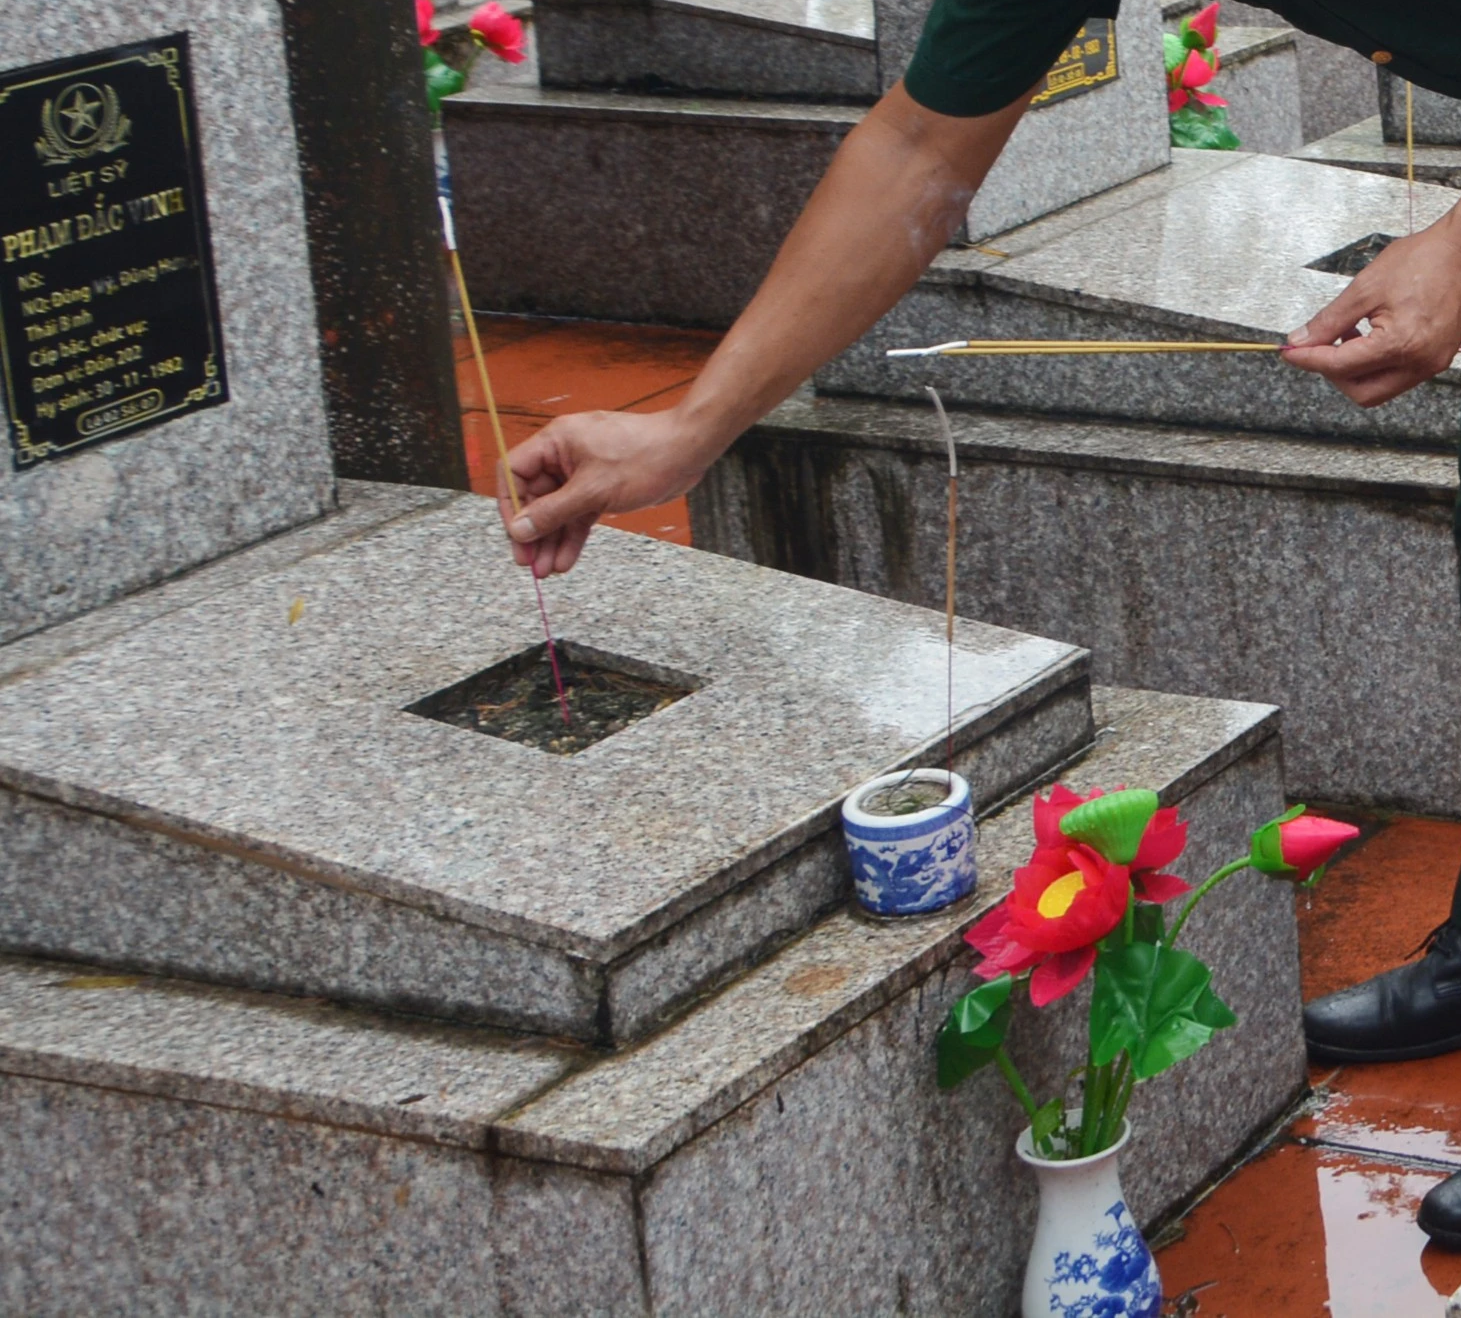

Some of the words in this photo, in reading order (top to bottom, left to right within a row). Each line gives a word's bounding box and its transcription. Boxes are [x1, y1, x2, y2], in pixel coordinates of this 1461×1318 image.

[47, 170, 95, 199] LIỆT
[2, 219, 73, 262] PHẠM
[76, 193, 125, 236] ĐẮC
[126, 187, 187, 225] VINH
